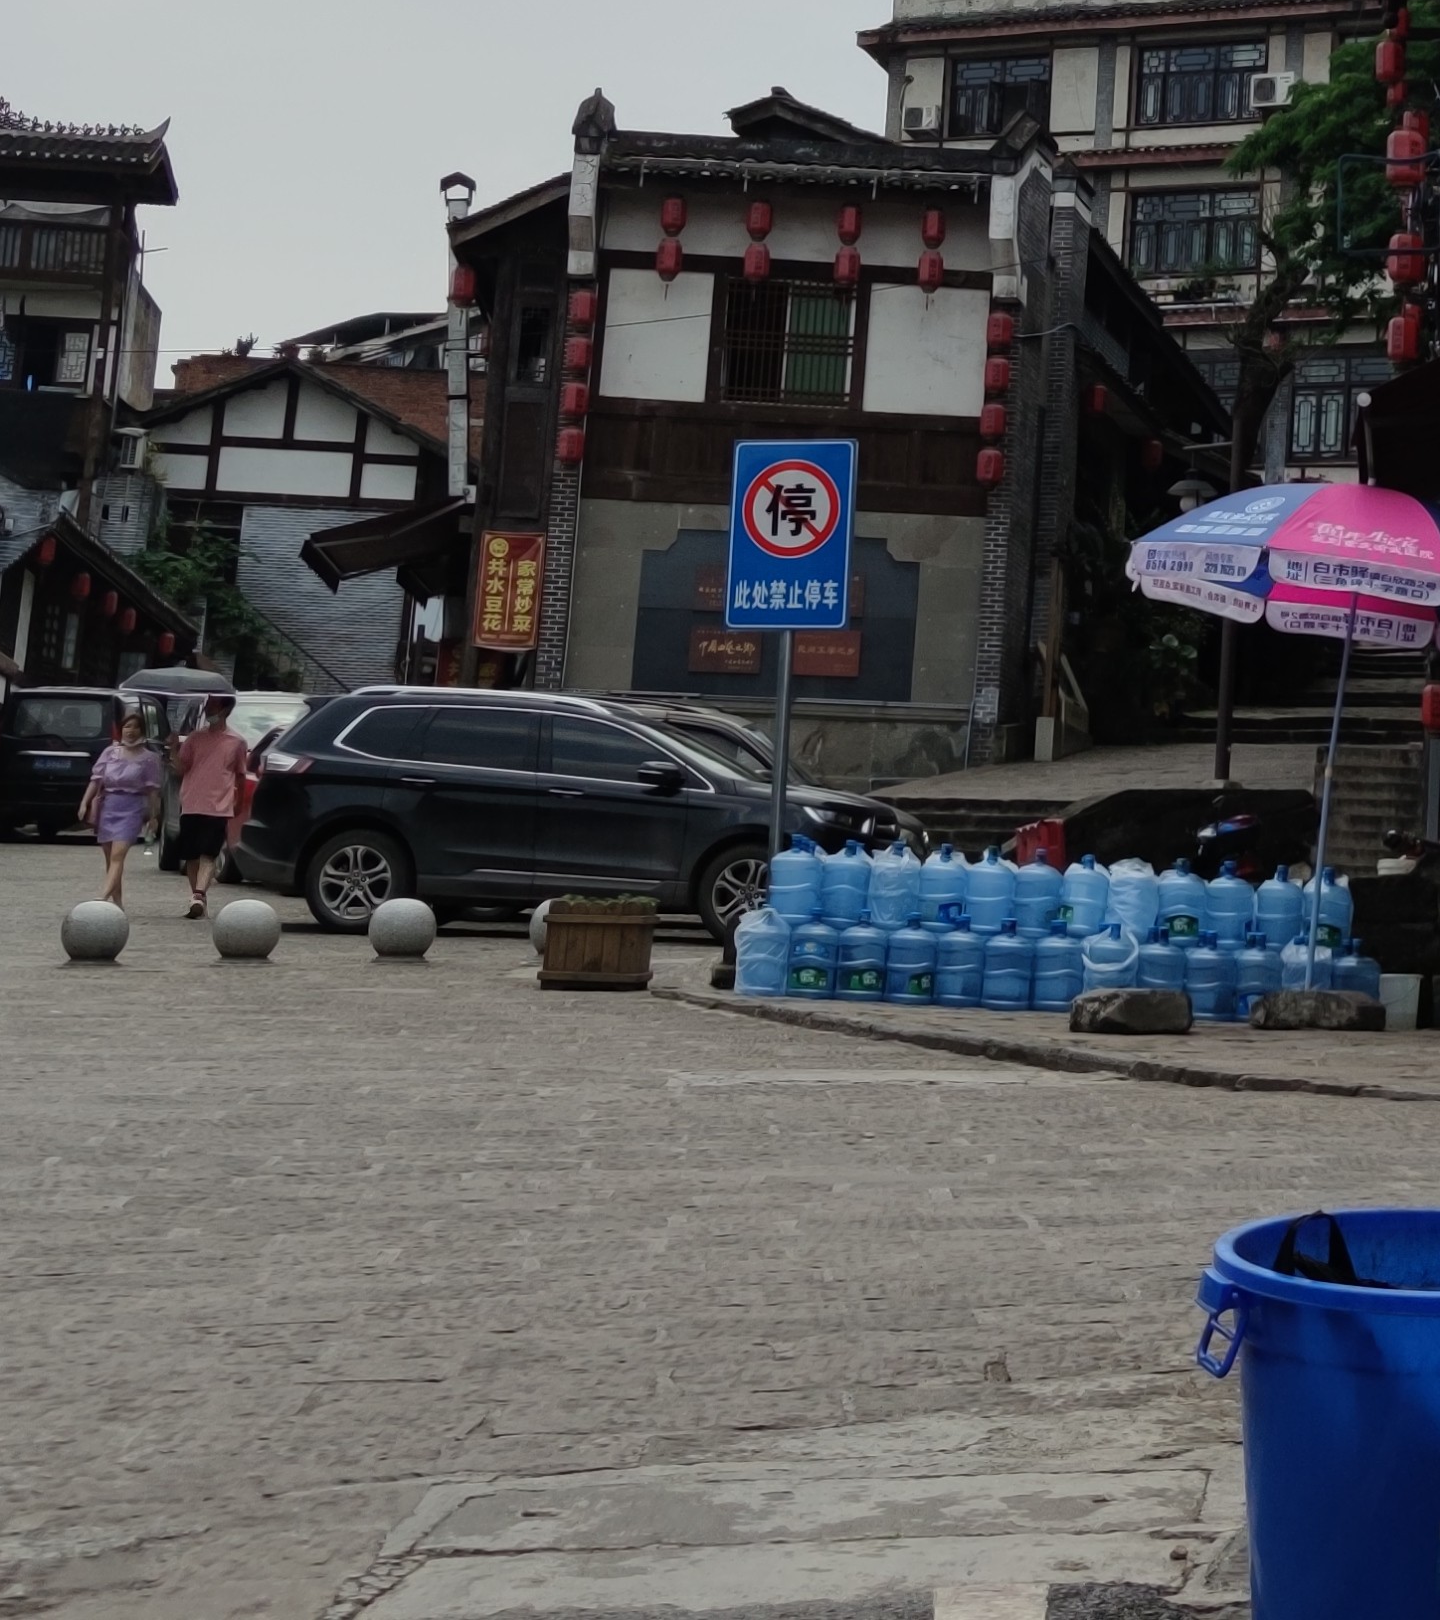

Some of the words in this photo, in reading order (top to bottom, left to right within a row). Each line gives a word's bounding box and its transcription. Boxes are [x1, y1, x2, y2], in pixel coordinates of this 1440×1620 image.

[766, 482, 817, 537] 停
[482, 558, 508, 632] 井水豆花
[512, 560, 537, 633] 家常炒菜
[733, 579, 840, 611] 此处禁止停车
